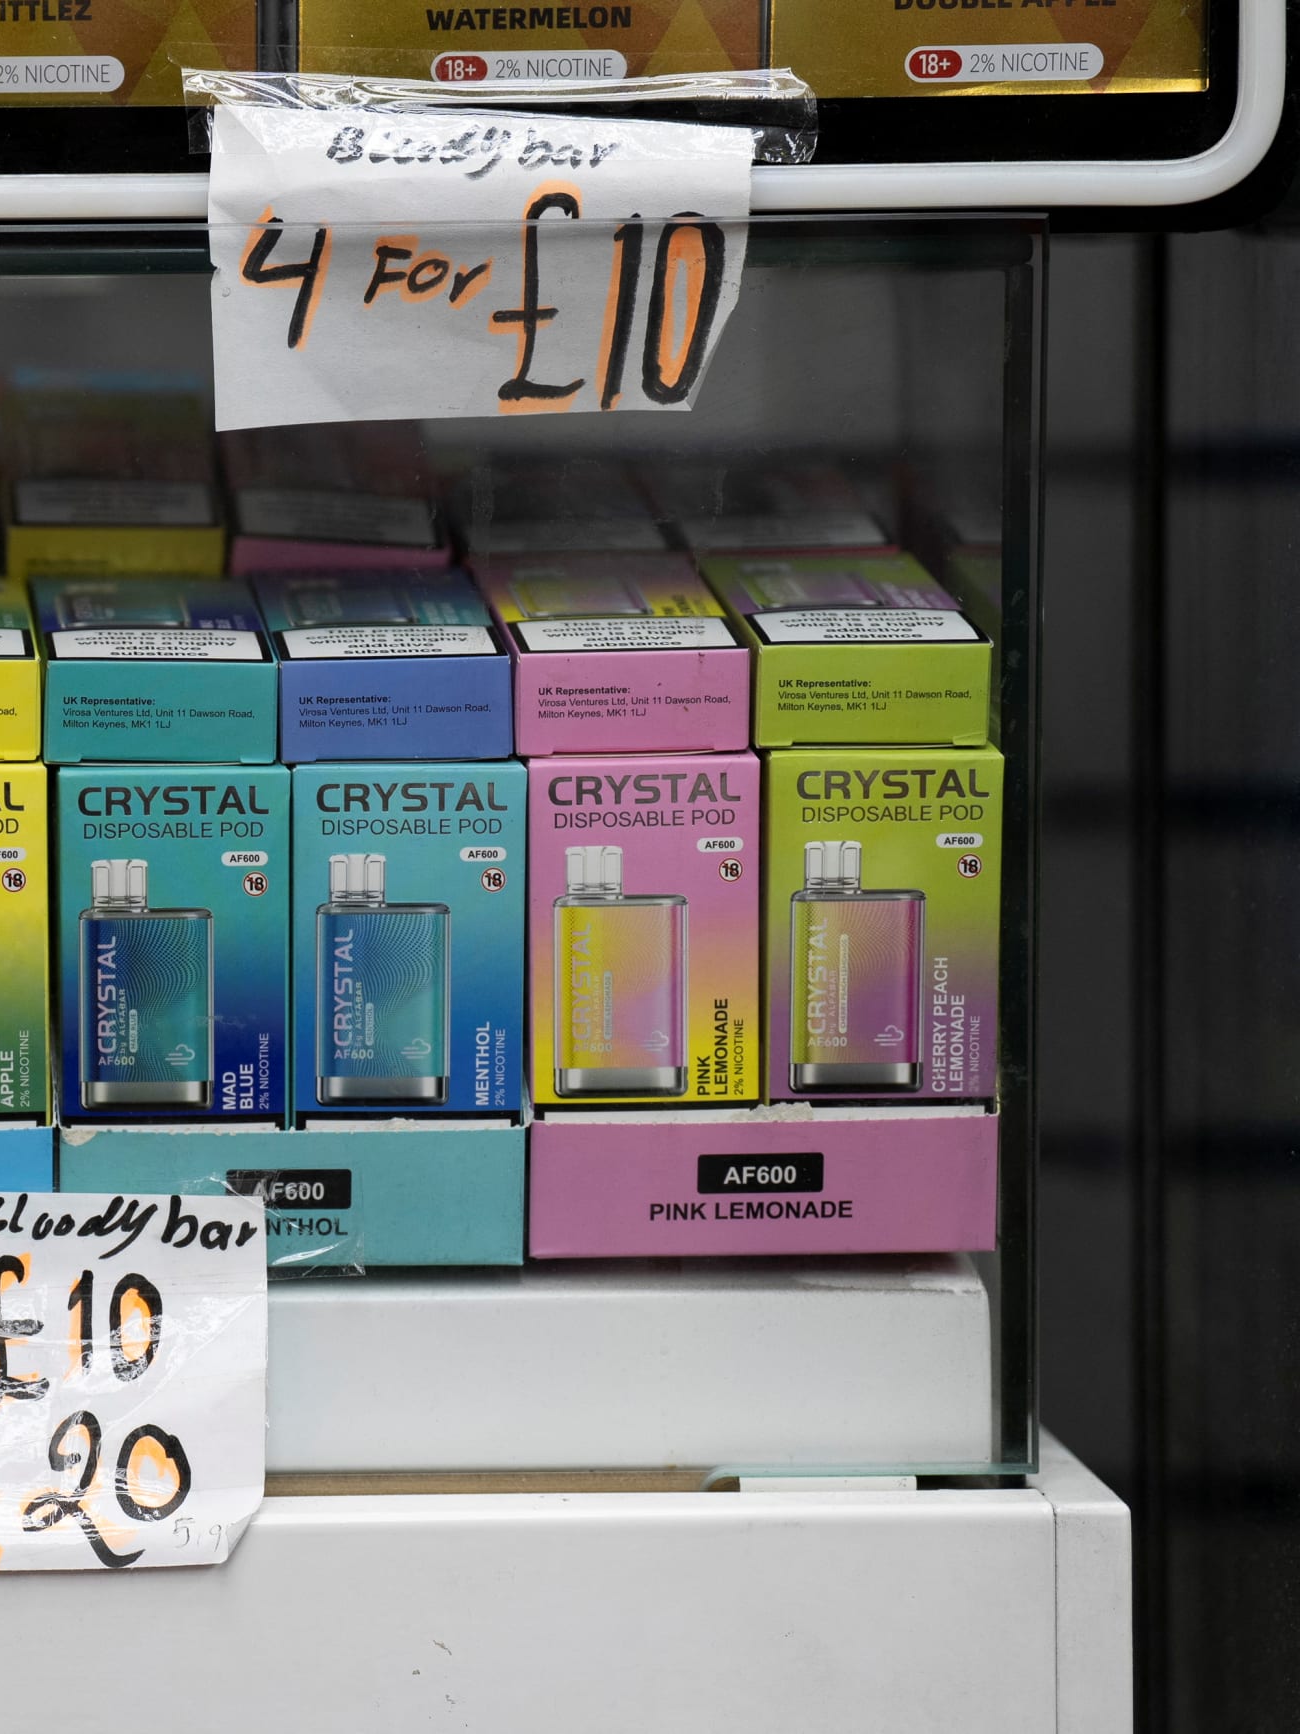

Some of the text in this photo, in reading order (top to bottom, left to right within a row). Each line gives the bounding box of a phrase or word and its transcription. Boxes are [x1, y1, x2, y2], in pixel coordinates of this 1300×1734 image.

[426, 7, 631, 30] WATERMELON
[26, 64, 110, 83] NICOTINE
[445, 58, 613, 80] 18+ 2% NICOTINE
[919, 52, 1089, 74] 18+ 2% NICOTINE
[241, 212, 330, 349] 4
[491, 188, 725, 411] £10
[548, 773, 741, 806] CRYSTAL
[797, 769, 989, 800] CRYSTAL
[78, 785, 269, 816] CRYSTAL
[316, 782, 507, 813] CRYSTAL
[554, 809, 735, 828] DISPOSABLE POD
[802, 805, 983, 822] DISPOSABLE POD
[84, 822, 263, 839] DISPOSABLE POD
[322, 819, 502, 835] DISPOSABLE POD
[705, 840, 735, 848] AF600
[944, 837, 974, 845] AF600
[468, 850, 498, 858] AF600
[932, 957, 948, 1092] CHERRY PEACH
[714, 999, 728, 1095] LEMONADE
[950, 994, 965, 1092] LEMONADE
[476, 1022, 490, 1106] MENTHOL
[0, 1051, 14, 1107] APPLE
[240, 1064, 254, 1110] BLUE
[697, 1056, 711, 1096] PINK
[223, 1071, 236, 1110] MAD
[724, 1167, 796, 1184] AF600
[650, 1201, 853, 1220] PINK LEMONADE
[267, 1217, 348, 1235] NTHOL
